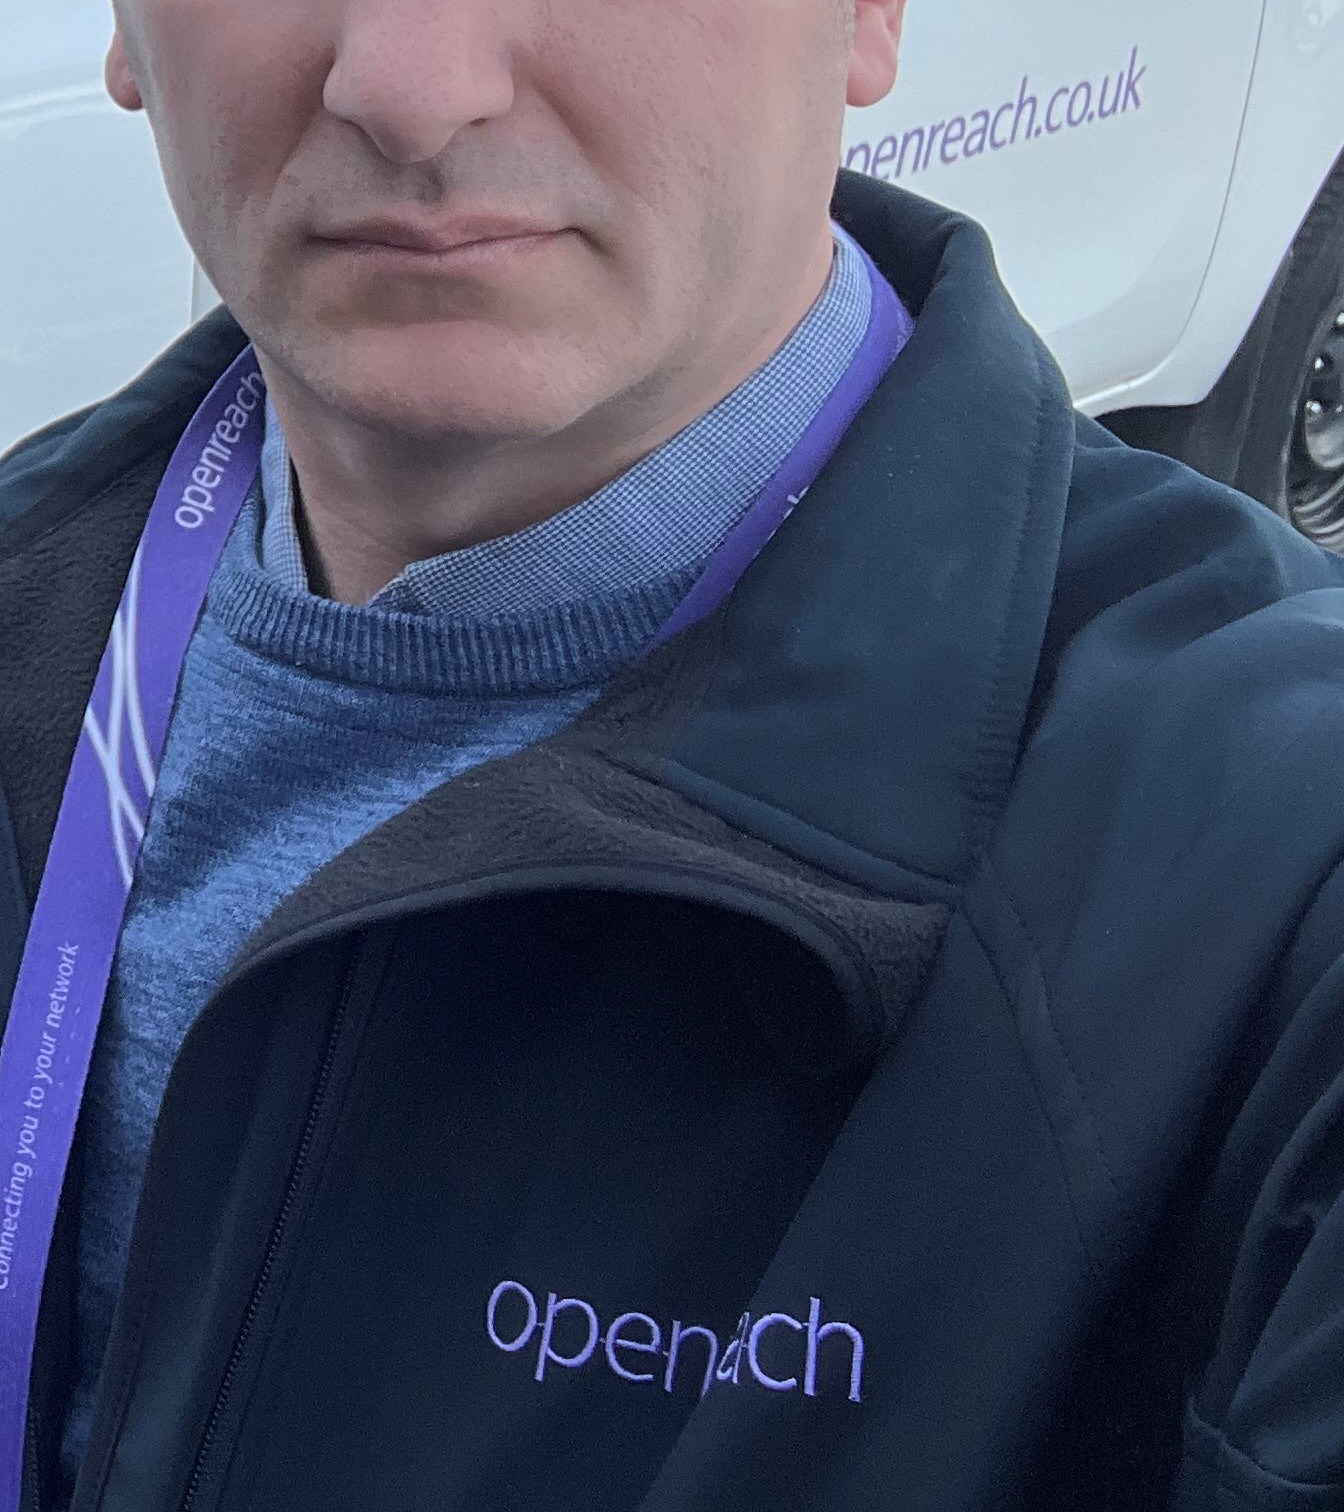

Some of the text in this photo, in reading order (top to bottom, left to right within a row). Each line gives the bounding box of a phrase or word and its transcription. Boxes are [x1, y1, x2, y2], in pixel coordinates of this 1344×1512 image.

[174, 371, 262, 529] openreach
[46, 942, 79, 1028] network
[33, 1030, 58, 1085] your
[23, 1086, 45, 1109] to
[16, 1114, 40, 1159] you
